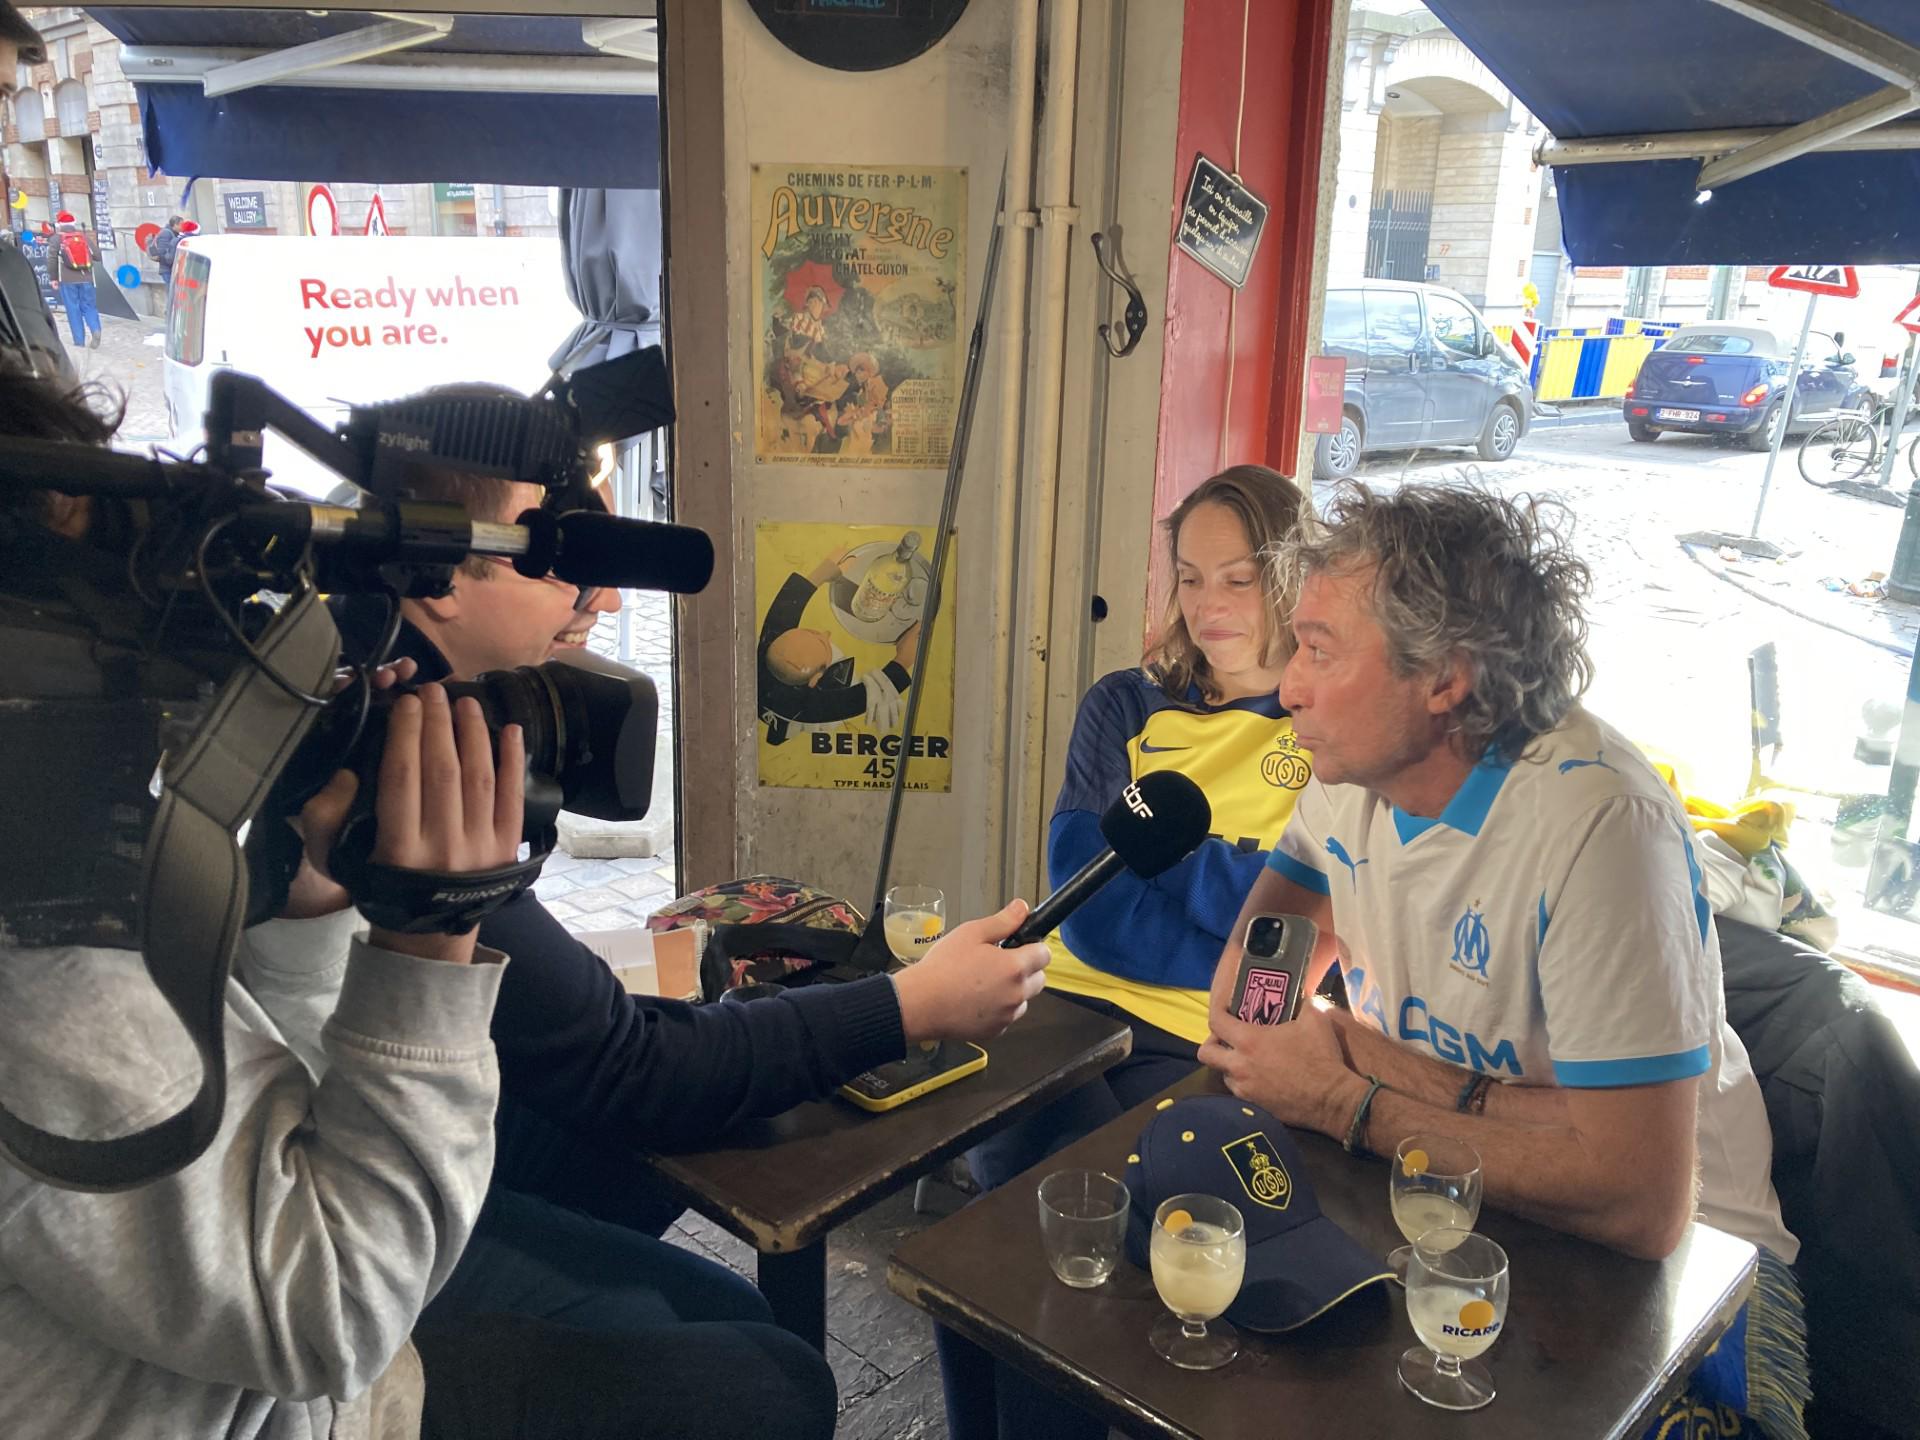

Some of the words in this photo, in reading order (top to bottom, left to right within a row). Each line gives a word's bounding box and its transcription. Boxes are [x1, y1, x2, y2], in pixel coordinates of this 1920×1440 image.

[787, 173, 844, 187] CHEMINS
[848, 174, 863, 188] DE
[867, 175, 889, 188] FER
[228, 196, 258, 209] WELCOME
[1214, 192, 1225, 204] on
[1225, 196, 1253, 225] travaille
[233, 210, 257, 224] GALLERY
[761, 186, 954, 260] Auvergne
[812, 233, 853, 247] VICHY
[824, 247, 867, 260] ROYAT
[300, 275, 416, 318] Ready
[426, 275, 519, 307] when
[304, 325, 372, 359] you
[382, 323, 448, 346] are.
[379, 431, 431, 452] zylight
[811, 732, 950, 758] BERGER
[862, 757, 896, 779] 45
[833, 780, 859, 788] TYPE
[863, 781, 929, 790] MARSLLAIS
[914, 932, 944, 945] RICAR
[1399, 996, 1524, 1076] CGM
